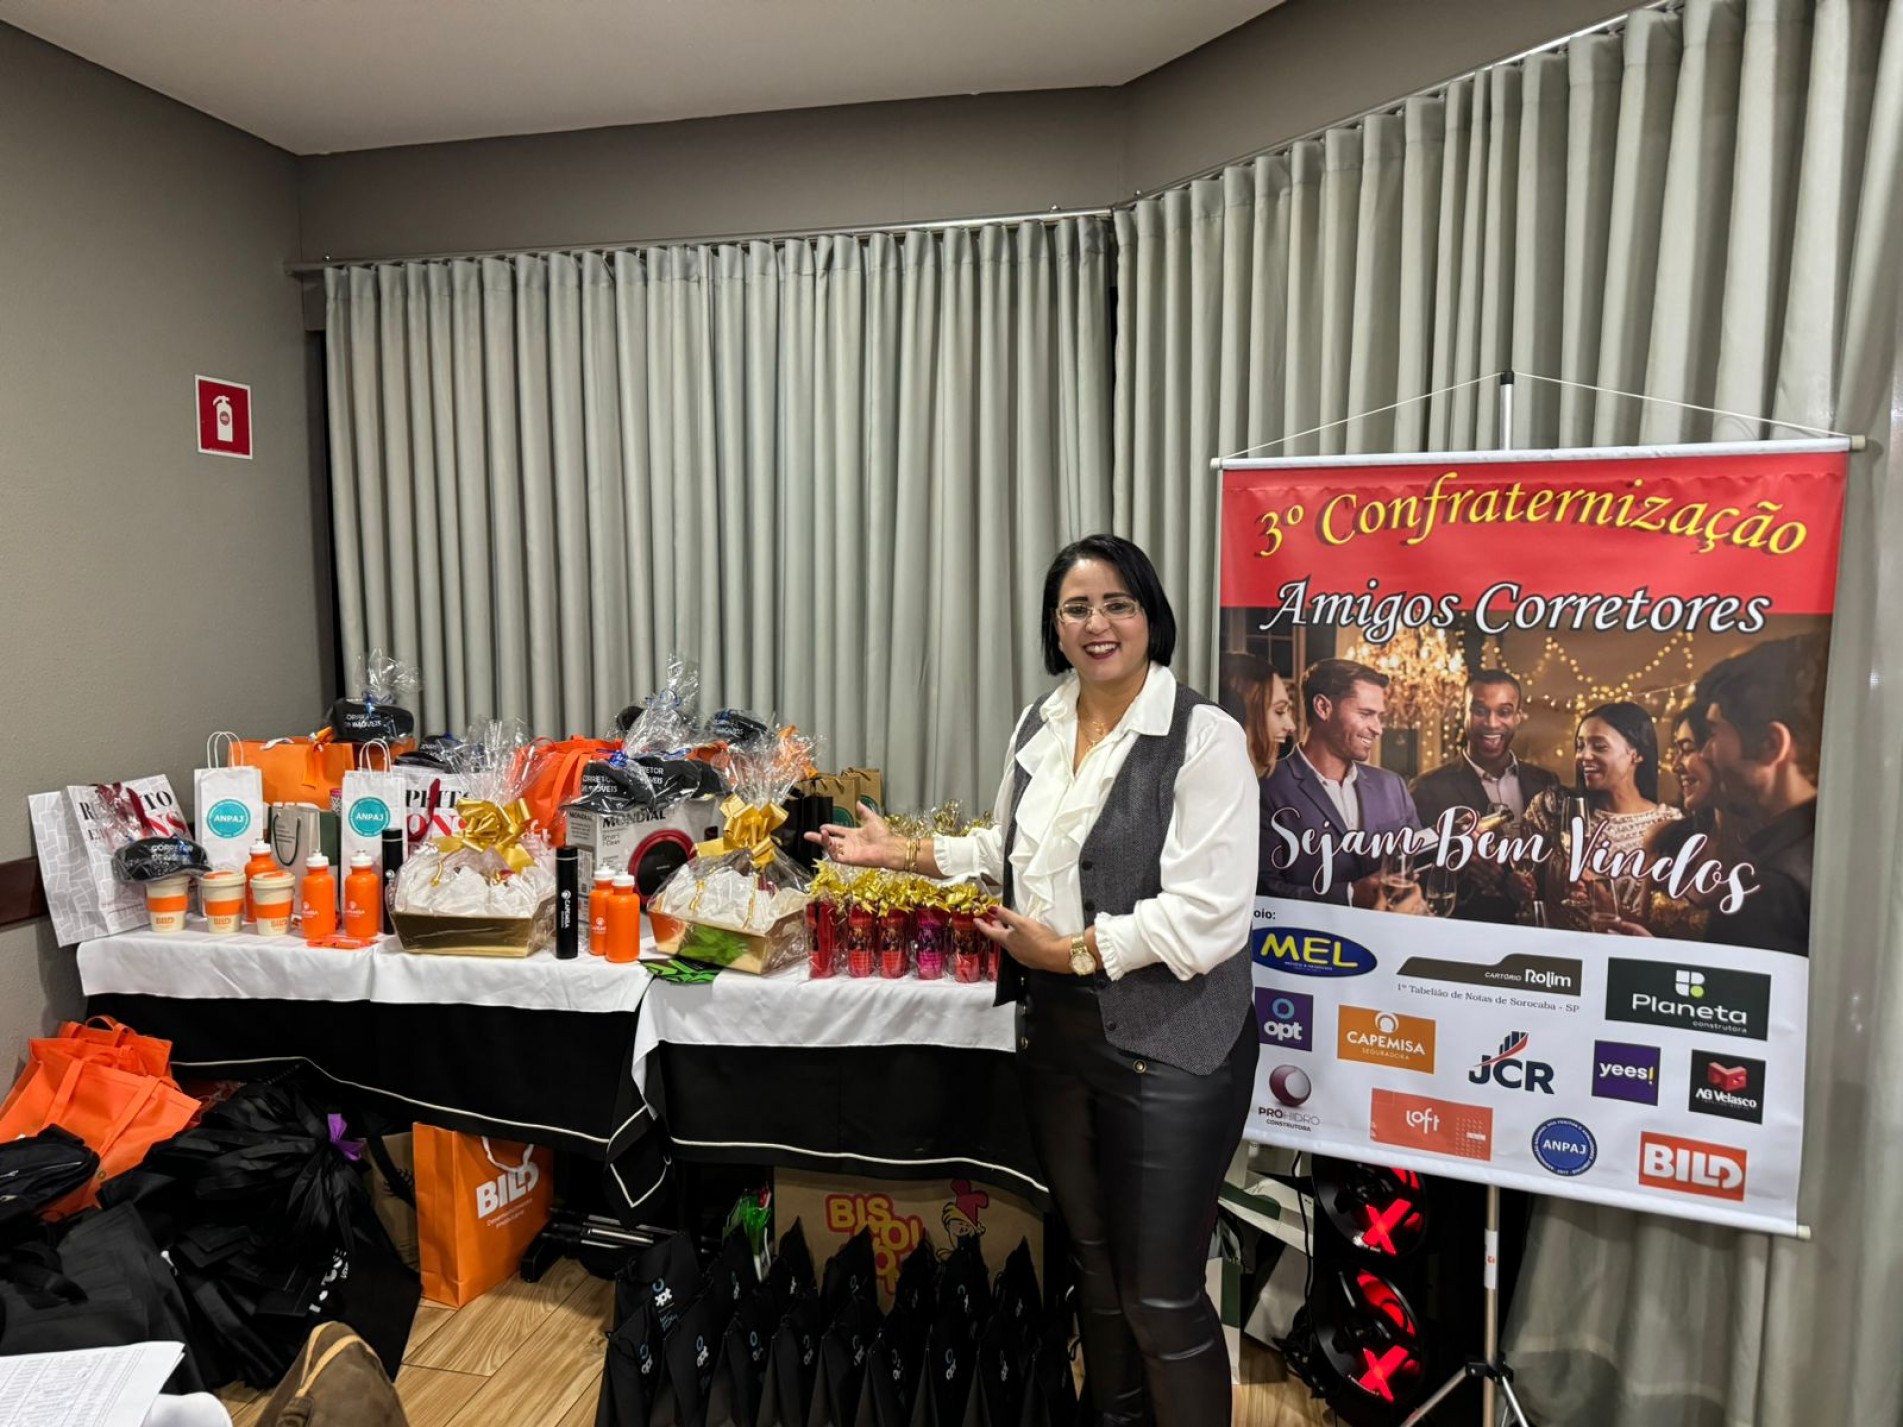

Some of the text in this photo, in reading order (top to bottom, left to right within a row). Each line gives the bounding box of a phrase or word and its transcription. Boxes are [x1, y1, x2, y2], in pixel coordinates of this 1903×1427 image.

[1321, 472, 1808, 556] Confraternização
[1257, 574, 1773, 643] Amigos Corretores
[213, 814, 245, 823] ANPAJ
[355, 812, 383, 822] ANPAJ
[1269, 806, 1761, 917] Sejam Bem Vindos
[1253, 908, 1276, 920] oio:
[1261, 933, 1358, 967] MEL
[1525, 968, 1572, 988] Rolim
[1409, 985, 1449, 998] Tabelião
[1451, 991, 1463, 999] de
[1465, 992, 1493, 1003] Notas
[1495, 996, 1507, 1005] de
[1510, 997, 1556, 1011] Sorocaba
[1566, 1004, 1580, 1013] SP
[1632, 993, 1748, 1025] Planeta
[1263, 1021, 1303, 1041] opt
[1692, 1020, 1748, 1034] construtora
[1346, 1030, 1426, 1056] CAPEMISA
[1362, 1047, 1410, 1060] SEGURADORA
[1468, 1054, 1555, 1095] JCR
[1599, 1062, 1654, 1085] yees!
[1713, 1089, 1758, 1109] Velasco
[1266, 1118, 1312, 1133] CONSTRUTORA
[1543, 1138, 1587, 1155] ANPAJ
[1643, 1141, 1744, 1190] BILD
[476, 1160, 540, 1220] BILD
